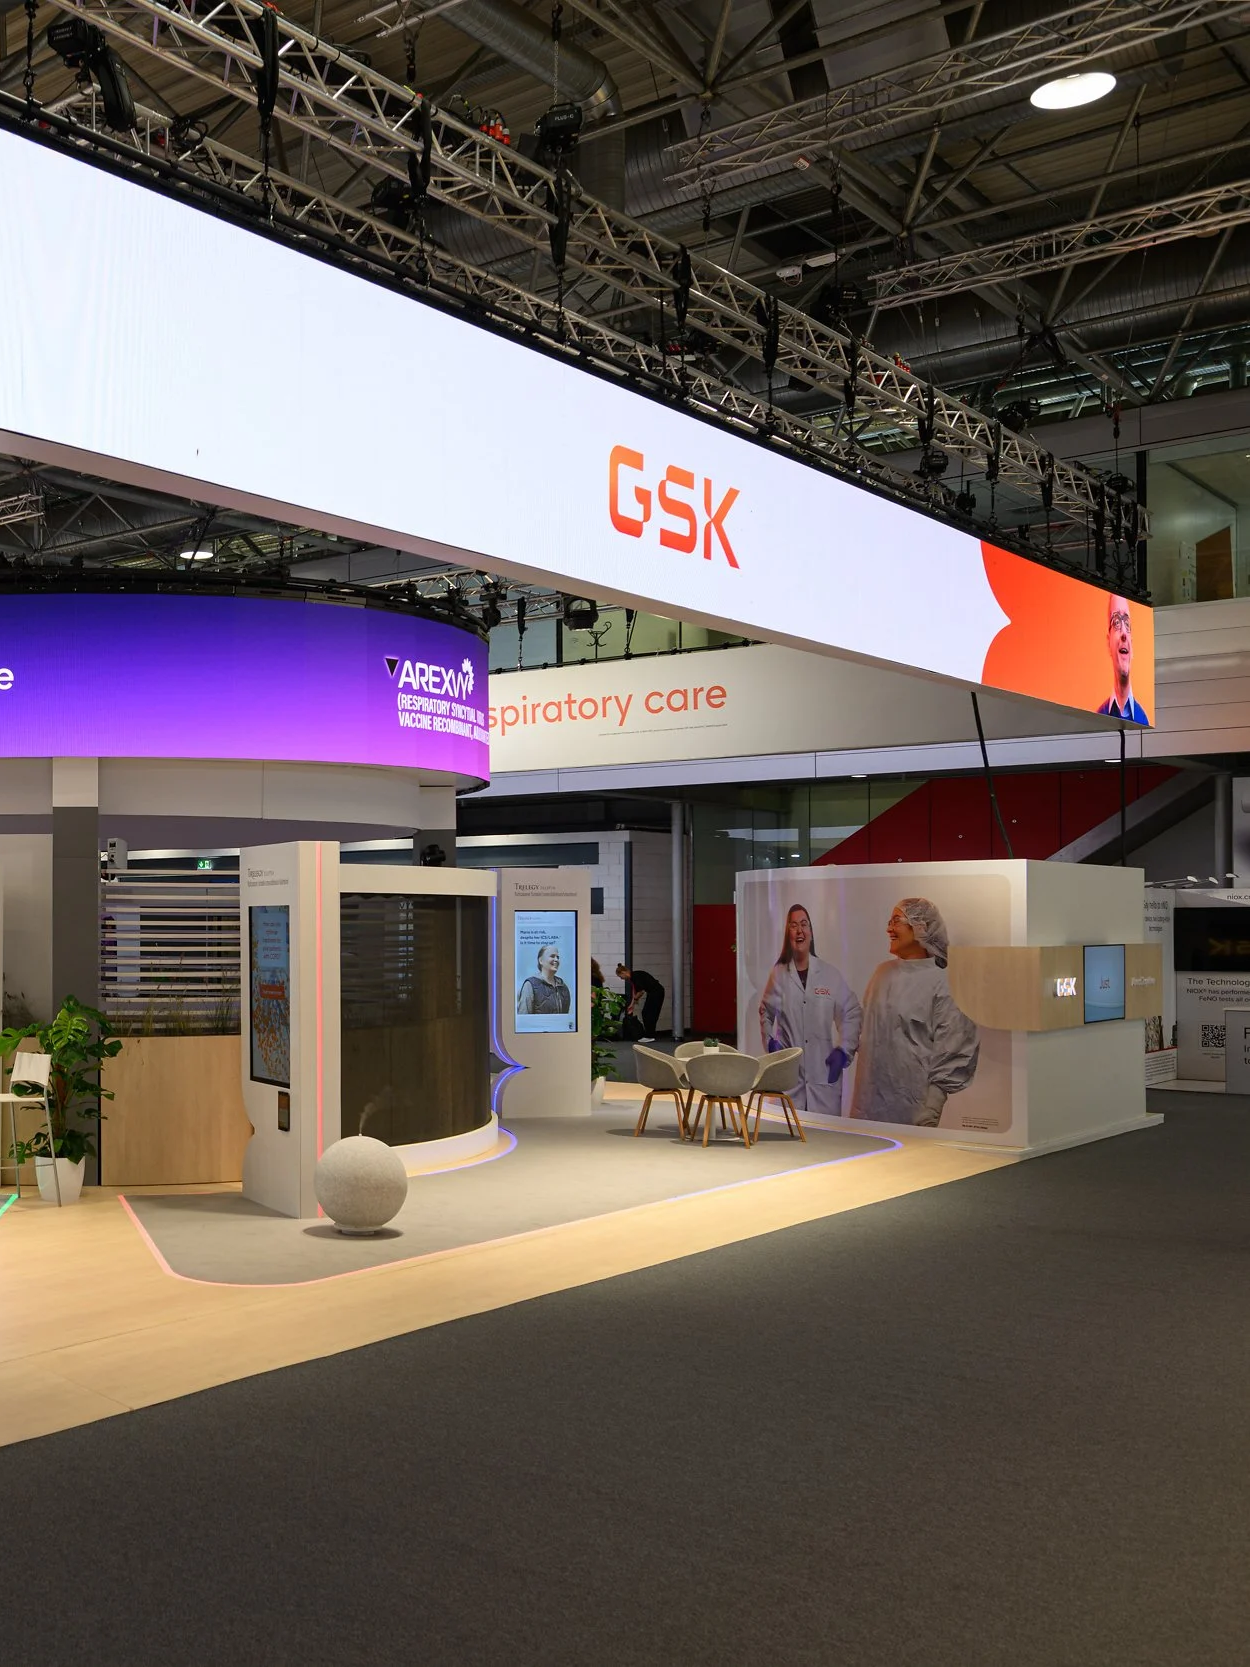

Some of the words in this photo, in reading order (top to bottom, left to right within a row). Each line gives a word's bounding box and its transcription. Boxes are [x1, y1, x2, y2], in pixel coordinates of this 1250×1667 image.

[608, 444, 741, 570] GSK
[644, 684, 727, 714] care
[398, 711, 432, 730] VACCINE
[1056, 977, 1077, 997] GSK
[1187, 977, 1203, 985] The
